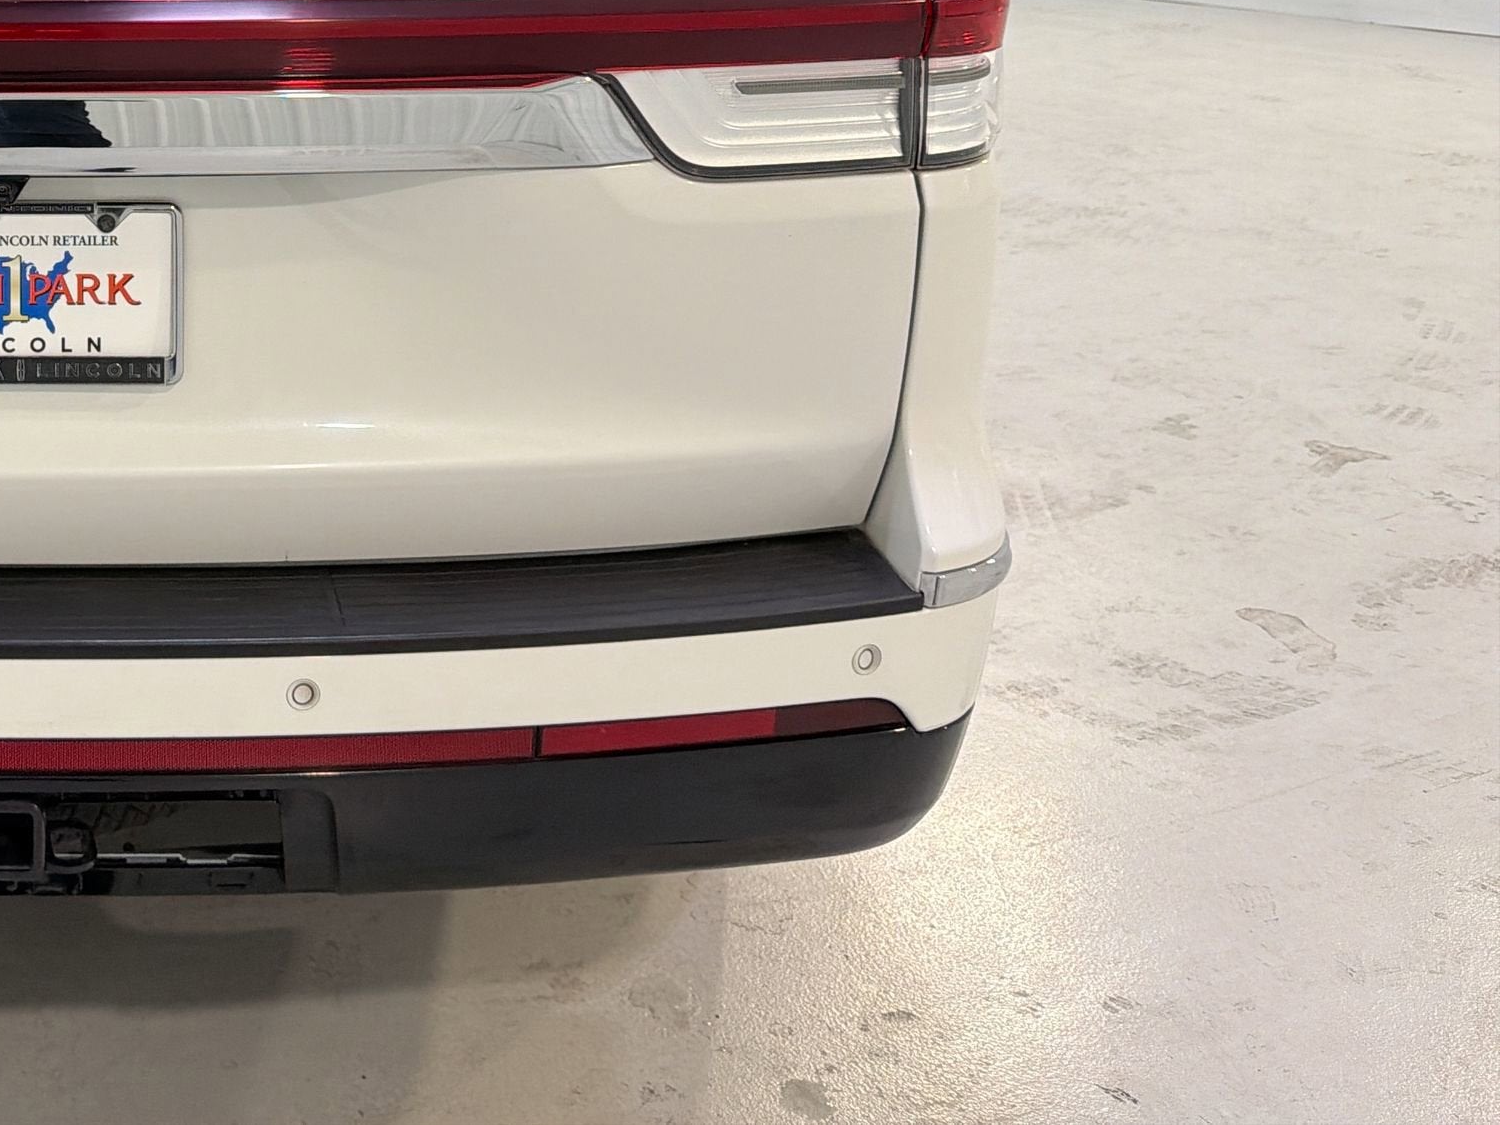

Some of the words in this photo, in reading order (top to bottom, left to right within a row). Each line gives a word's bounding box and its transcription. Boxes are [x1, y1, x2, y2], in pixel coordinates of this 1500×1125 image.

[52, 235, 119, 247] RETAILER
[28, 273, 142, 306] PARK
[36, 362, 161, 378] LINCOLN
